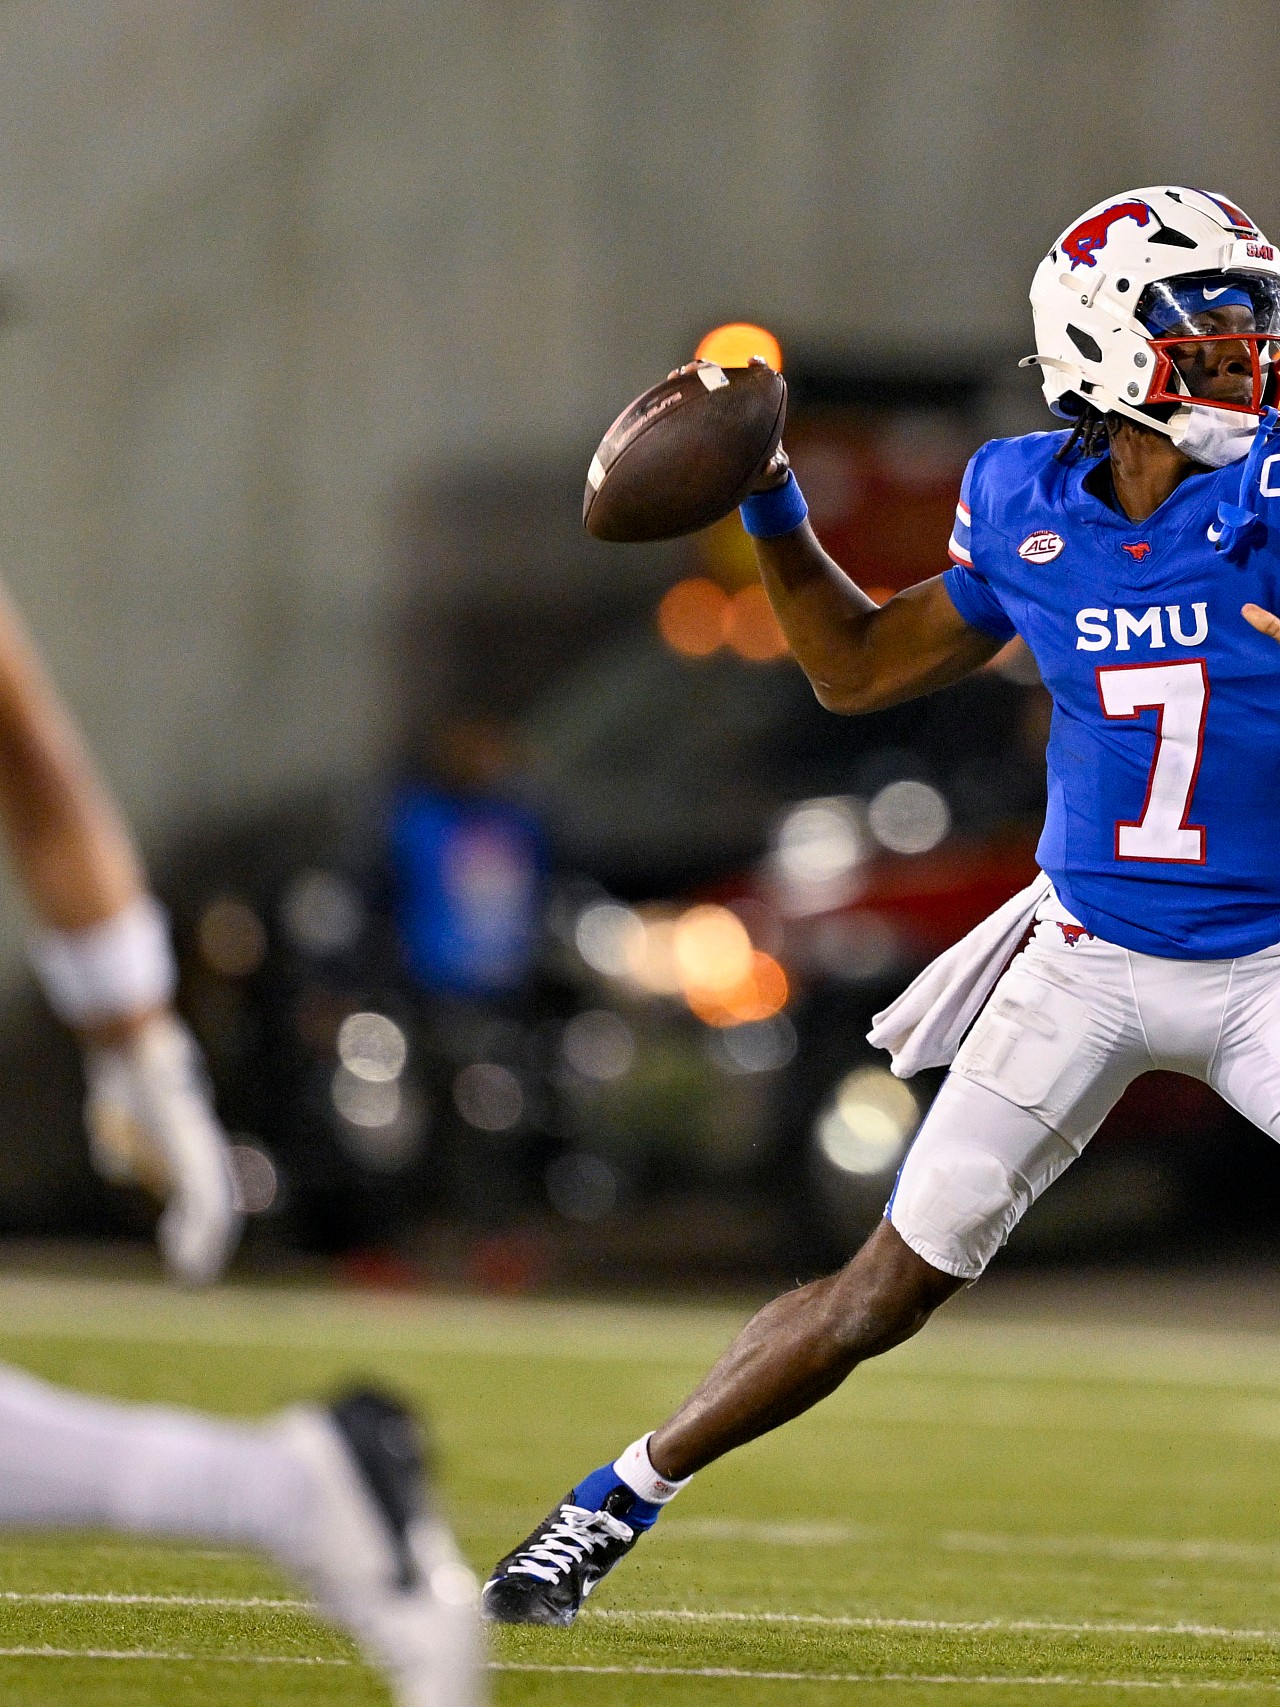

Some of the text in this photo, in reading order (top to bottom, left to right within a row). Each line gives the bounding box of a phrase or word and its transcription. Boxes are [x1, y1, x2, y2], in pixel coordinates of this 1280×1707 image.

[1246, 242, 1274, 261] SMU
[1025, 536, 1058, 553] ACC
[1075, 602, 1209, 651] SMU
[1094, 657, 1211, 866] 7
